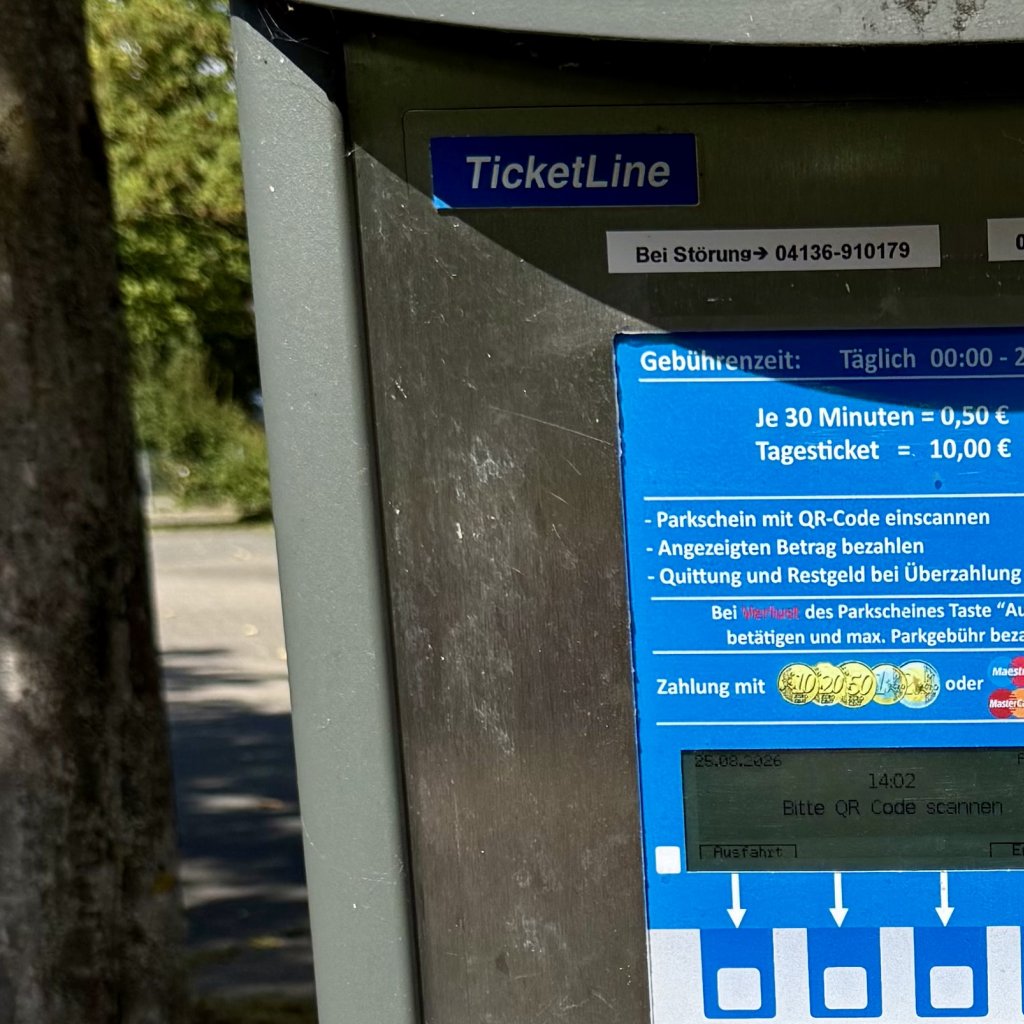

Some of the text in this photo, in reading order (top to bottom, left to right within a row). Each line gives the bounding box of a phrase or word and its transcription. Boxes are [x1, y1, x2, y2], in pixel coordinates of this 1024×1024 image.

[466, 154, 671, 189] TicketLine
[636, 246, 667, 263] Bei
[775, 242, 910, 262] 04136-910179
[640, 350, 801, 373] Gebührenzeit:
[840, 349, 915, 370] Täglich
[930, 348, 993, 368] 00:00
[755, 408, 779, 429] Je
[785, 408, 812, 428] 30
[819, 407, 915, 428] Minuten
[940, 406, 989, 429] 0,50
[995, 406, 1010, 425] €
[755, 441, 880, 463] Tagesticket
[930, 439, 991, 461] 10,00
[997, 439, 1012, 458] €
[657, 510, 756, 528] Parkschein
[762, 509, 793, 528] mit
[799, 509, 880, 529] QR-Code
[885, 508, 990, 526] einscannen
[658, 538, 771, 560] Angezeigten
[776, 538, 837, 559] Betrag
[842, 537, 924, 555] bezahlen
[660, 567, 742, 588] Quittung
[748, 566, 781, 585] und
[788, 566, 866, 586] Restgeld
[871, 565, 899, 583] bei
[905, 562, 1021, 585] Überzahlung
[712, 604, 737, 622] Bei
[805, 602, 832, 620] des
[838, 601, 944, 619] Parkscheines
[949, 601, 991, 618] Taste
[726, 627, 804, 648] betätigen
[810, 627, 842, 644] und
[848, 630, 885, 644] max.
[891, 627, 985, 647] Parkgebühr
[657, 675, 984, 701] Zahlung mit oder
[868, 773, 916, 789] 14:02
[783, 800, 1004, 816] Bitte QR Code scannen
[713, 846, 783, 859] Ausfahrt
